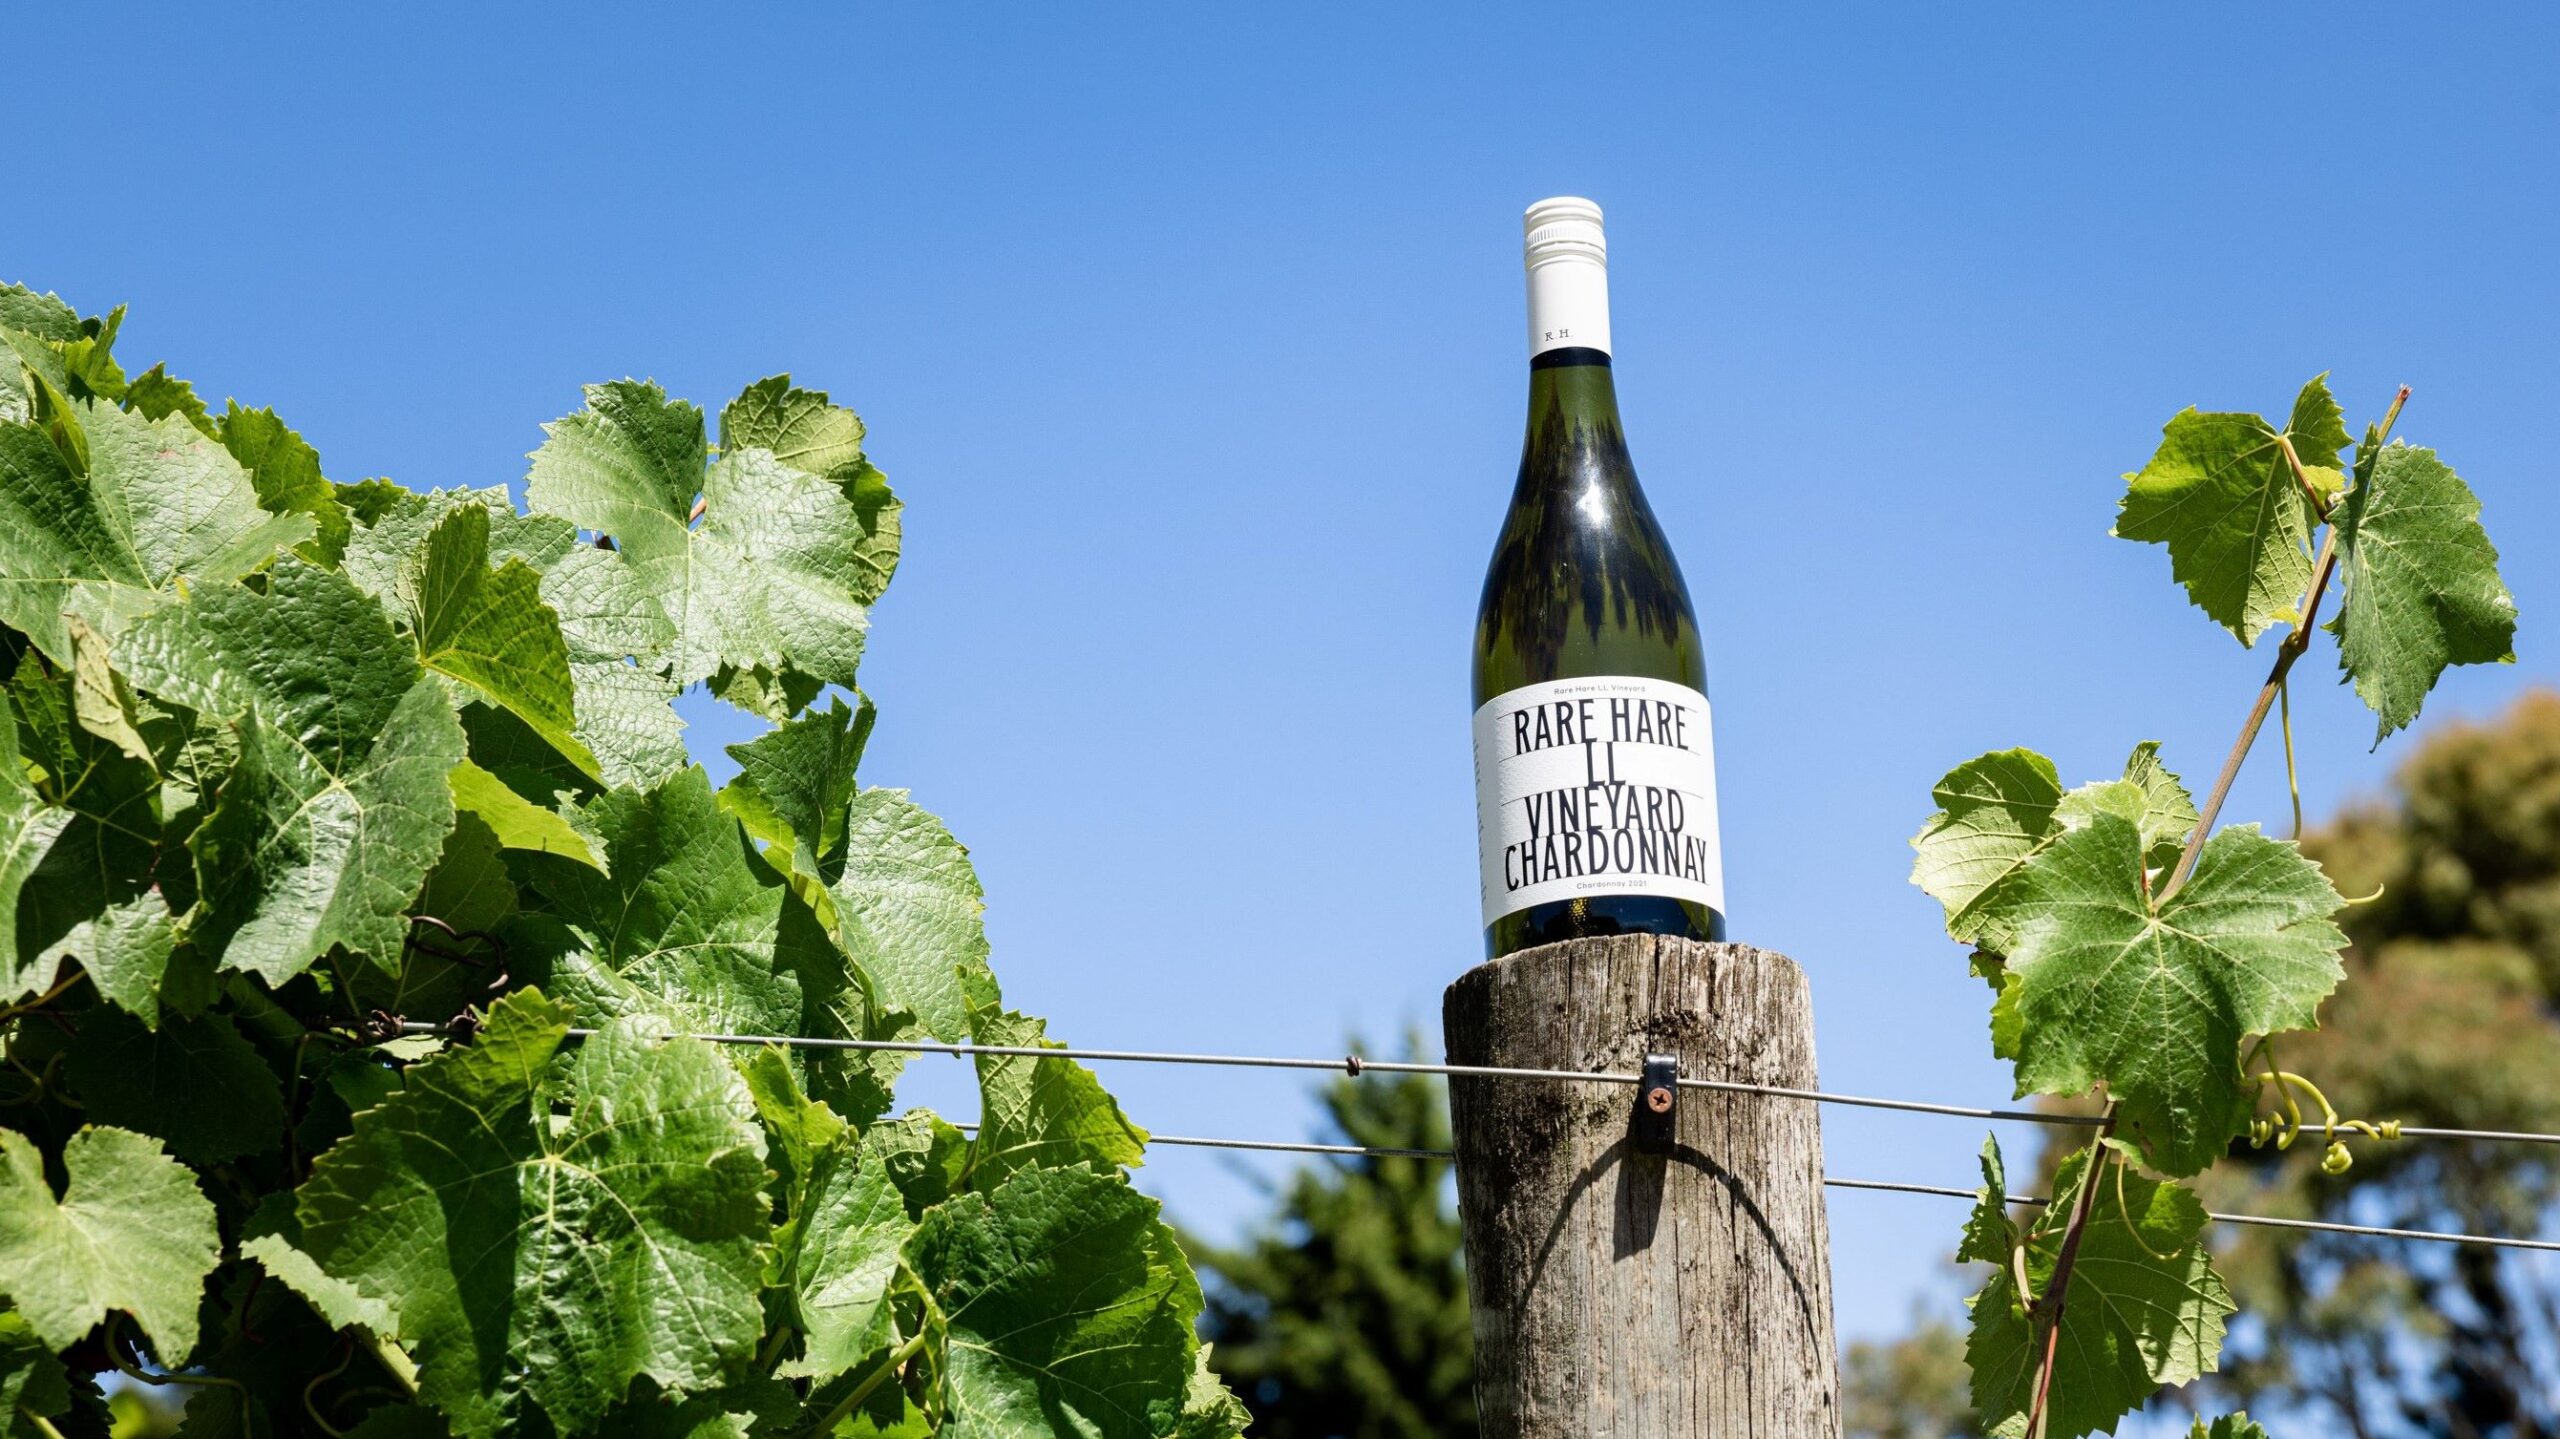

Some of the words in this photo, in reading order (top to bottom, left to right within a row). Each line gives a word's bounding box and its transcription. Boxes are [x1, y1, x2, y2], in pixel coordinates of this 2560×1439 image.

[1553, 687, 1574, 695] Rare
[1575, 685, 1596, 693] Hare
[1611, 684, 1646, 693] Vineyard
[1514, 698, 1598, 756] RARE
[1610, 697, 1690, 750] HARE
[1524, 785, 1686, 840] VINEYARD
[1505, 829, 1707, 892] CHARDONNAY
[1576, 881, 1626, 890] Chardonnay
